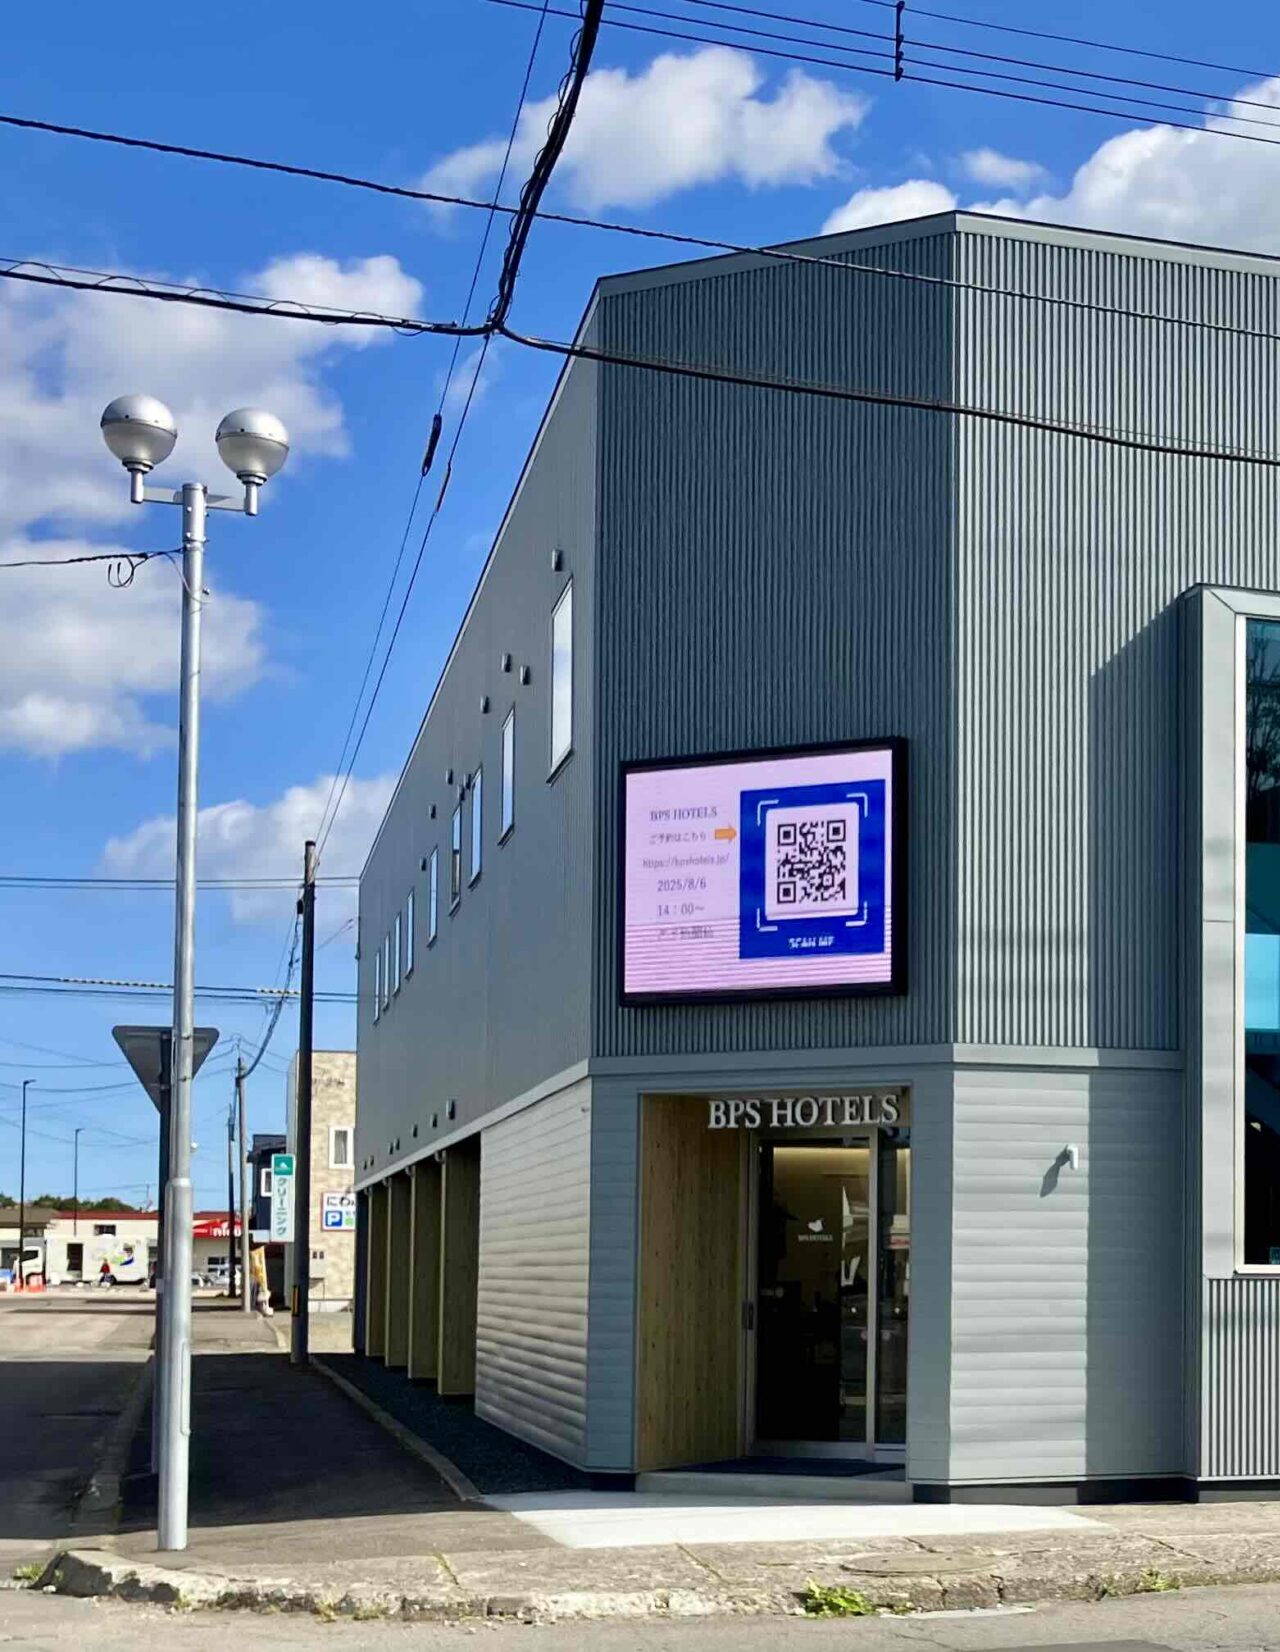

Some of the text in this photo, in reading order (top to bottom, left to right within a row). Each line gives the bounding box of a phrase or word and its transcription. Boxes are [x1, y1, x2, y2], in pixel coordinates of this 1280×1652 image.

[650, 806, 718, 821] BPS HOTELS
[657, 877, 707, 892] 2025/8/6
[708, 1094, 898, 1129] BPS HOTELS
[276, 1177, 288, 1236] クリーニング
